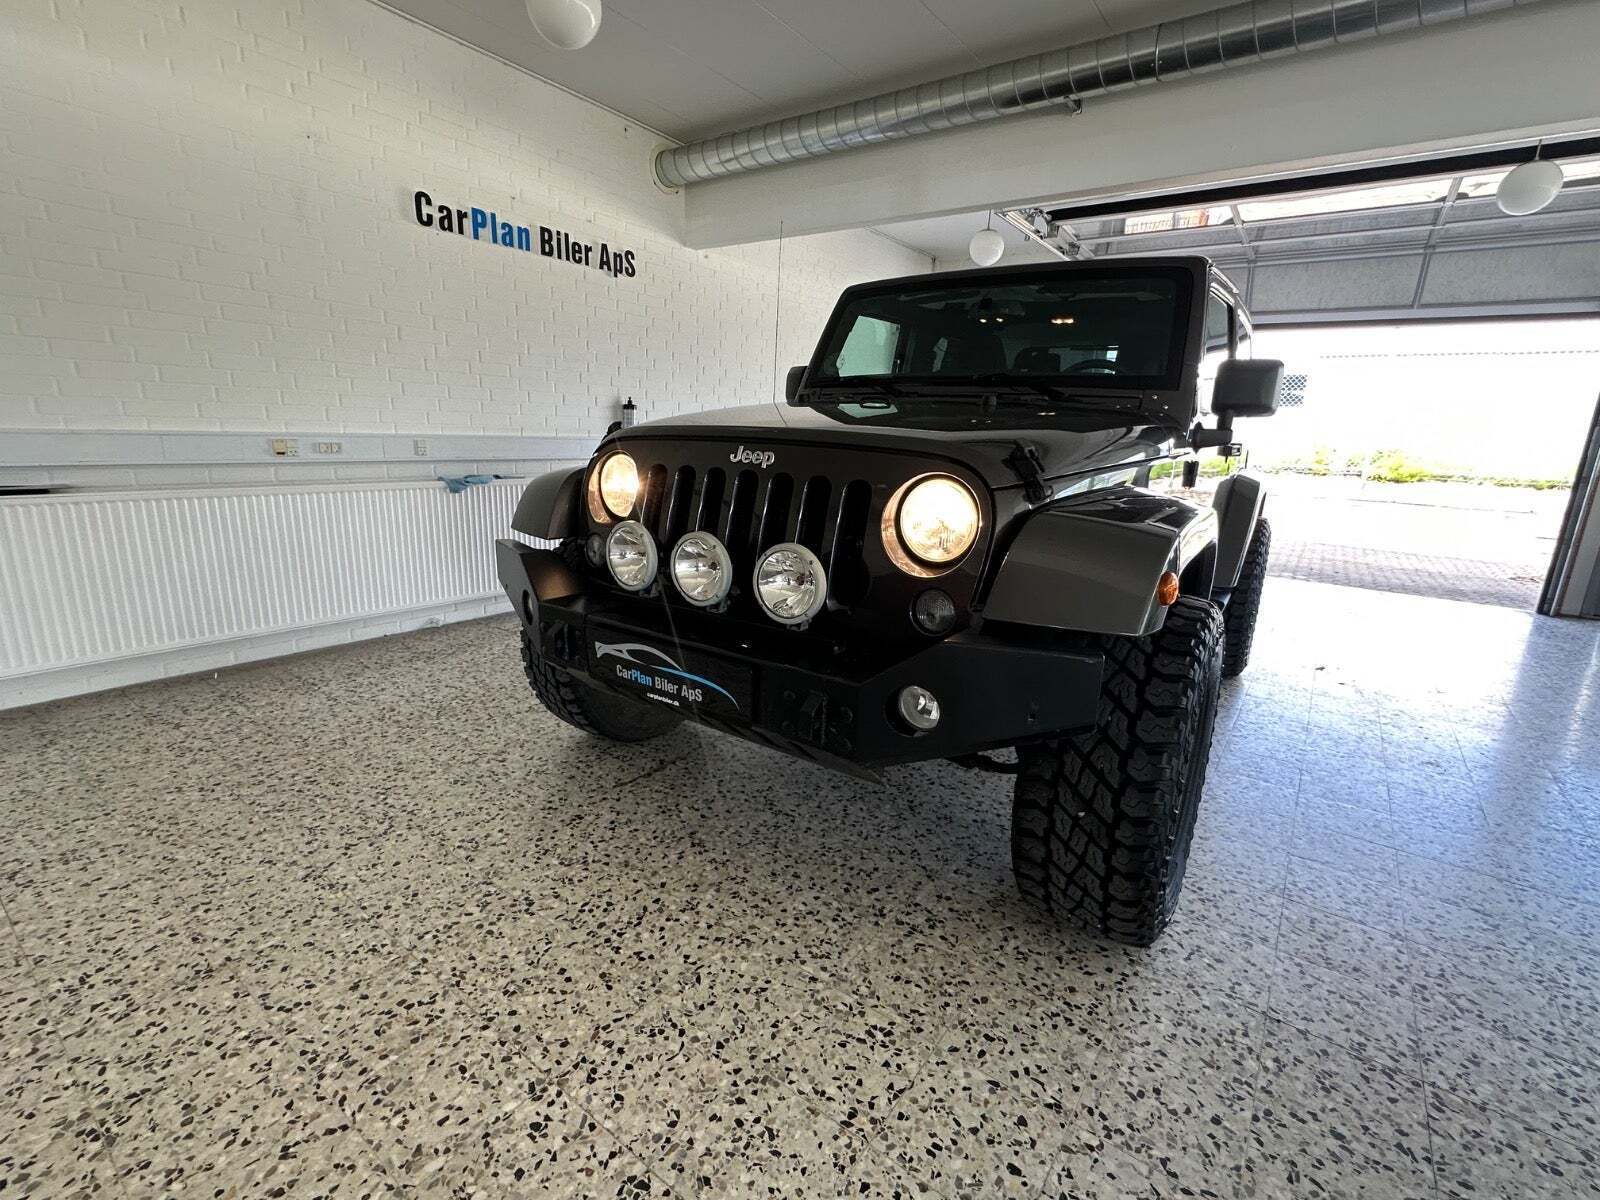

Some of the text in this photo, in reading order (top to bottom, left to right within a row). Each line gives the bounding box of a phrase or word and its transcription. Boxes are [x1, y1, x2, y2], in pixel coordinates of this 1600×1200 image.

[414, 190, 636, 278] CarPlan Biler ApS
[729, 445, 775, 469] Jeep
[616, 664, 703, 702] CarPlan Biler ApS
